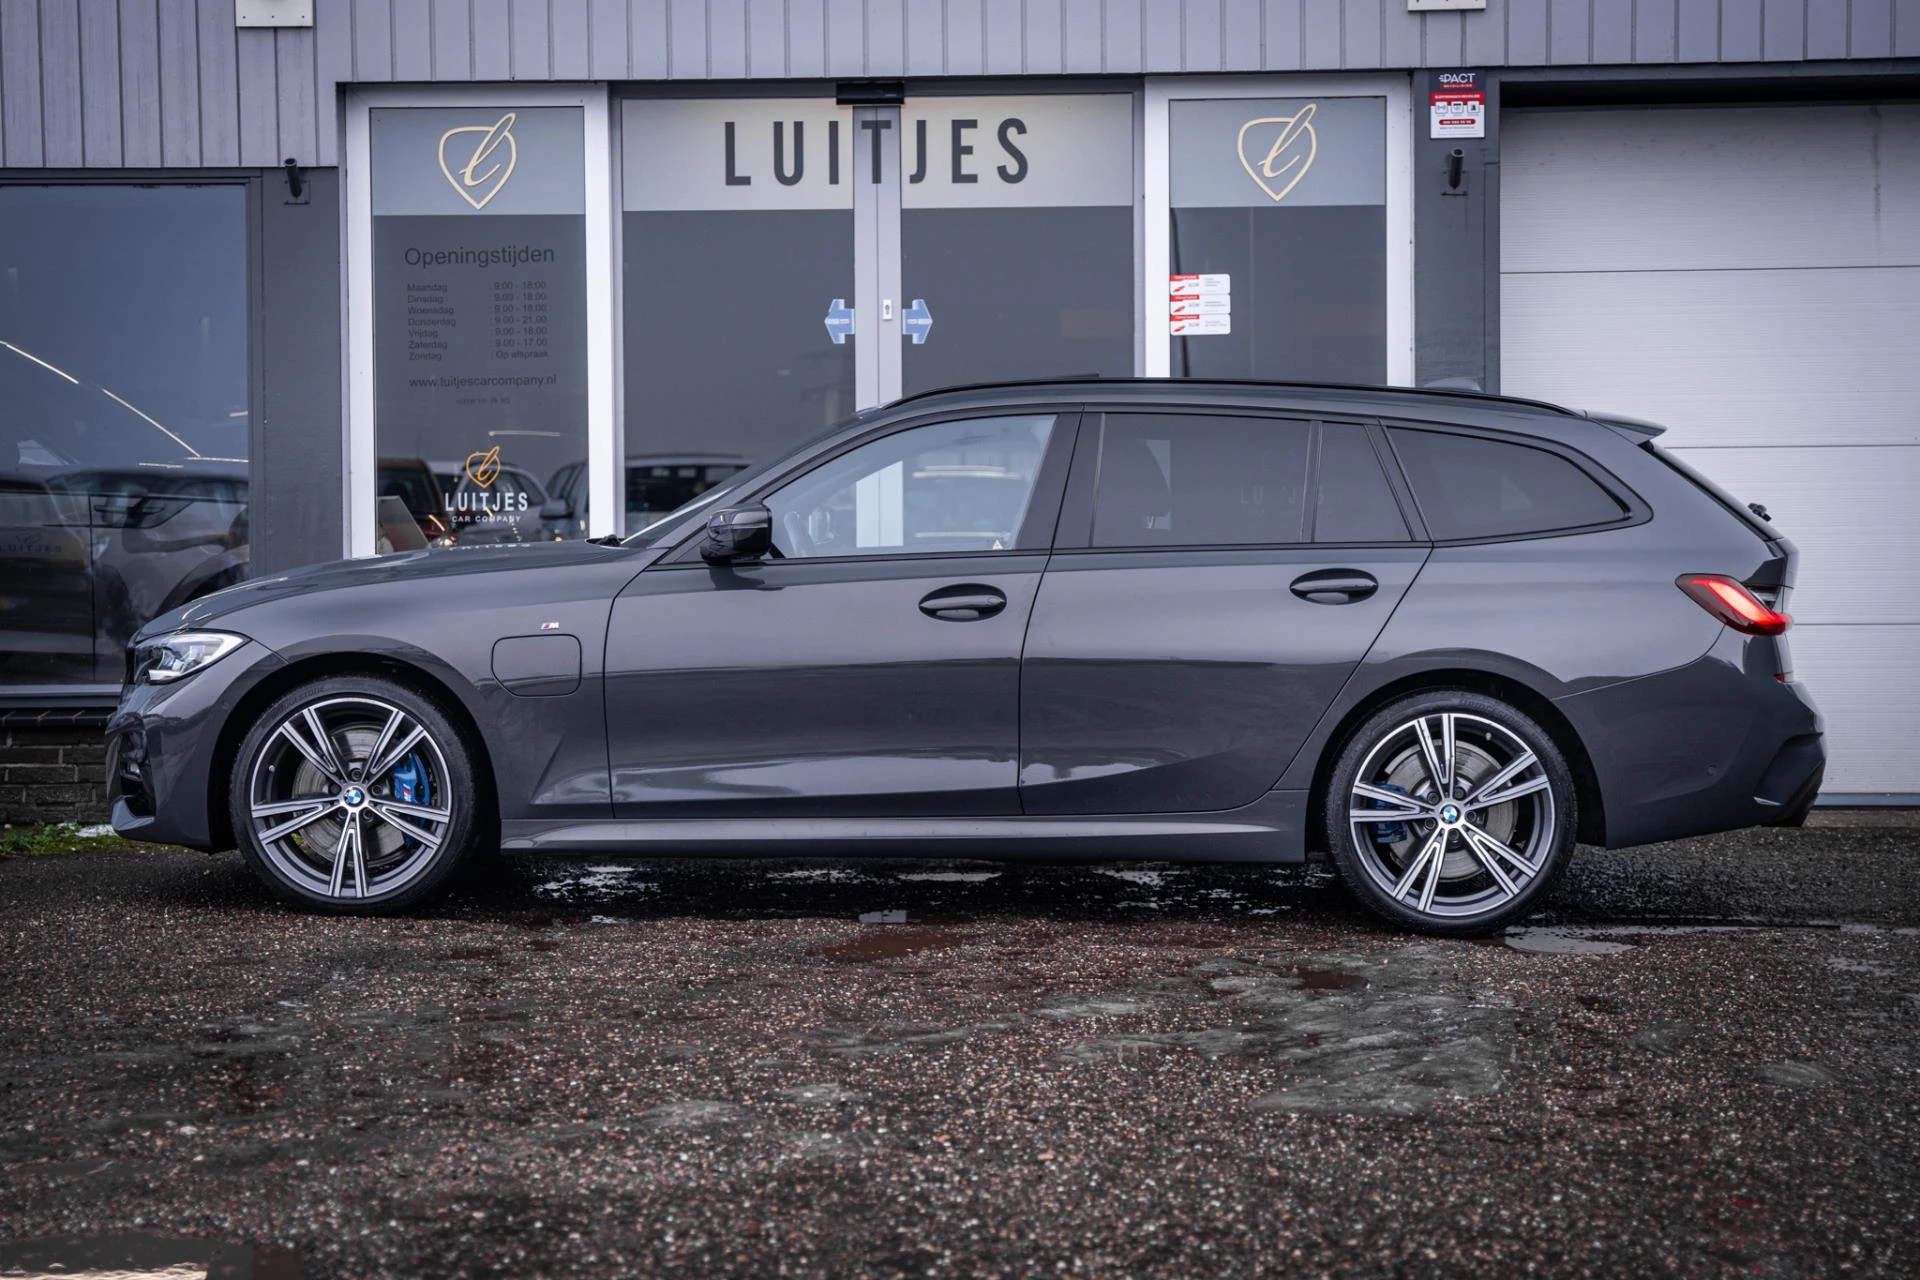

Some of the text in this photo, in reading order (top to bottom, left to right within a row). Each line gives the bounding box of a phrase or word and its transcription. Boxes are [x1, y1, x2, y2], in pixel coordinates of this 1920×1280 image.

[1440, 73, 1476, 83] PACT
[724, 118, 1028, 186] LUITJES
[404, 245, 555, 269] Openingstijden
[408, 374, 557, 390] www.luitjescarcompany.nl
[444, 491, 528, 512] LUITJES
[475, 515, 522, 523] COMPANY
